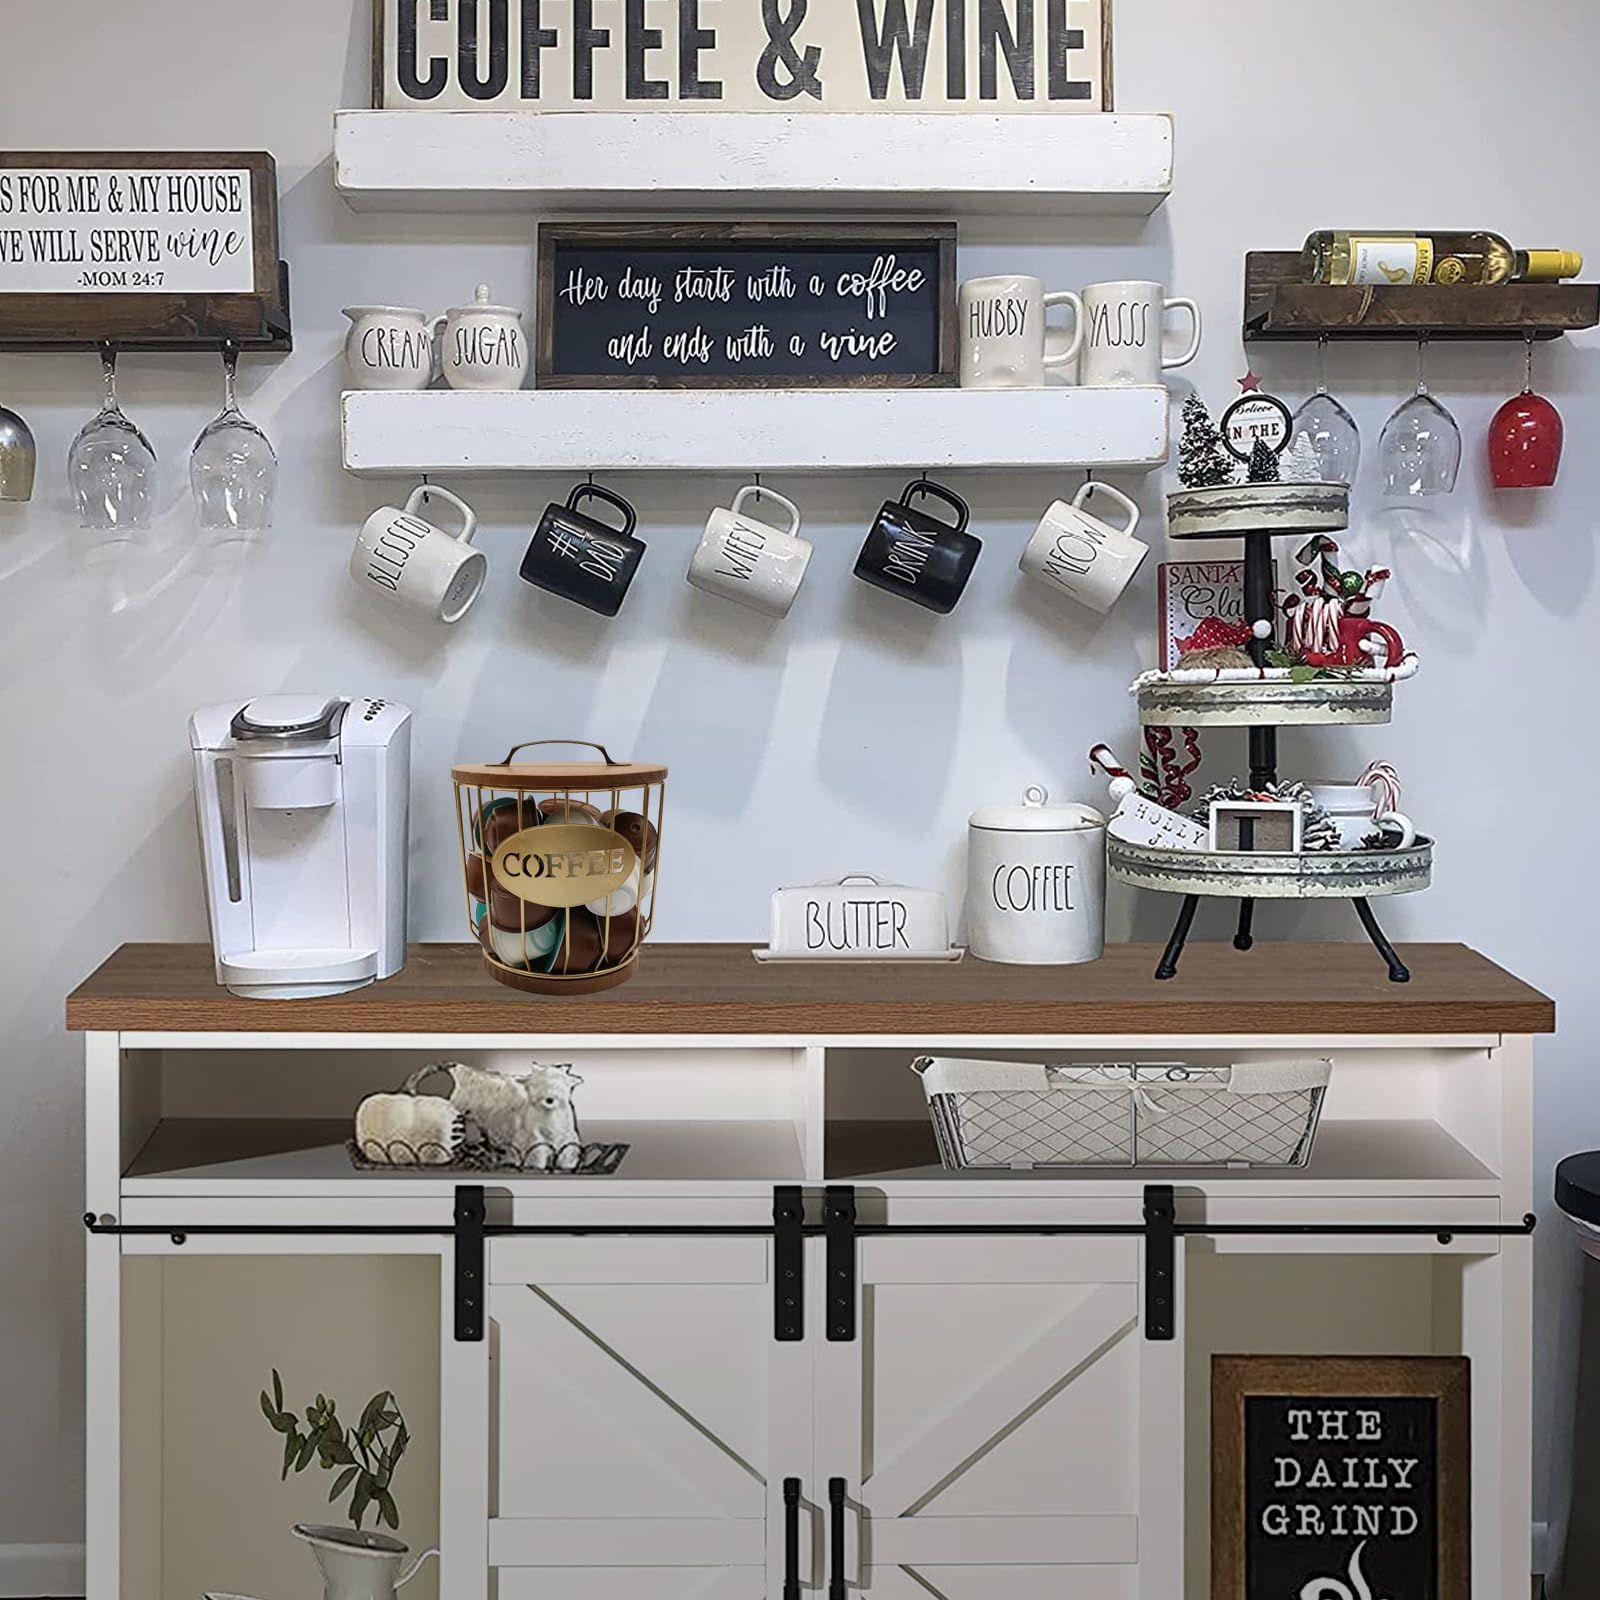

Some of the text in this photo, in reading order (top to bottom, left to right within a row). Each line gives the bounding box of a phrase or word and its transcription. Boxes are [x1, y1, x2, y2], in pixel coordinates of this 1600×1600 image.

[399, 0, 1093, 100] COFFEE & WINE
[18, 176, 62, 213] FOR
[66, 176, 101, 213] ME
[108, 175, 123, 213] &
[128, 176, 163, 213] MY
[166, 175, 243, 213] HOUSE
[28, 230, 85, 263] WILL
[90, 229, 161, 263] SERVE
[166, 227, 245, 267] wine
[77, 271, 165, 287] -MOM 24:7
[559, 253, 926, 320] Her day starts with a coffee
[969, 298, 1028, 339] HUBBY
[1088, 302, 1150, 348] YASSS
[361, 327, 431, 369] CREAM
[452, 326, 521, 369] SUGAR
[607, 324, 898, 366] and ends with a wine
[1249, 422, 1280, 438] THE
[366, 515, 431, 593] BLESSED
[546, 519, 587, 560] #1
[713, 520, 768, 581] WIFEY
[881, 519, 940, 585] DRINK
[1041, 513, 1110, 594] MEOW
[1169, 564, 1242, 586] SANTA
[1134, 803, 1206, 845] HOLLY
[502, 847, 625, 879] COFFEE
[992, 864, 1075, 912] COFFEE
[805, 900, 910, 950] BUTTER
[1287, 1409, 1382, 1440] THE
[1273, 1456, 1419, 1489] DAILY
[1261, 1504, 1419, 1536] GRIND
